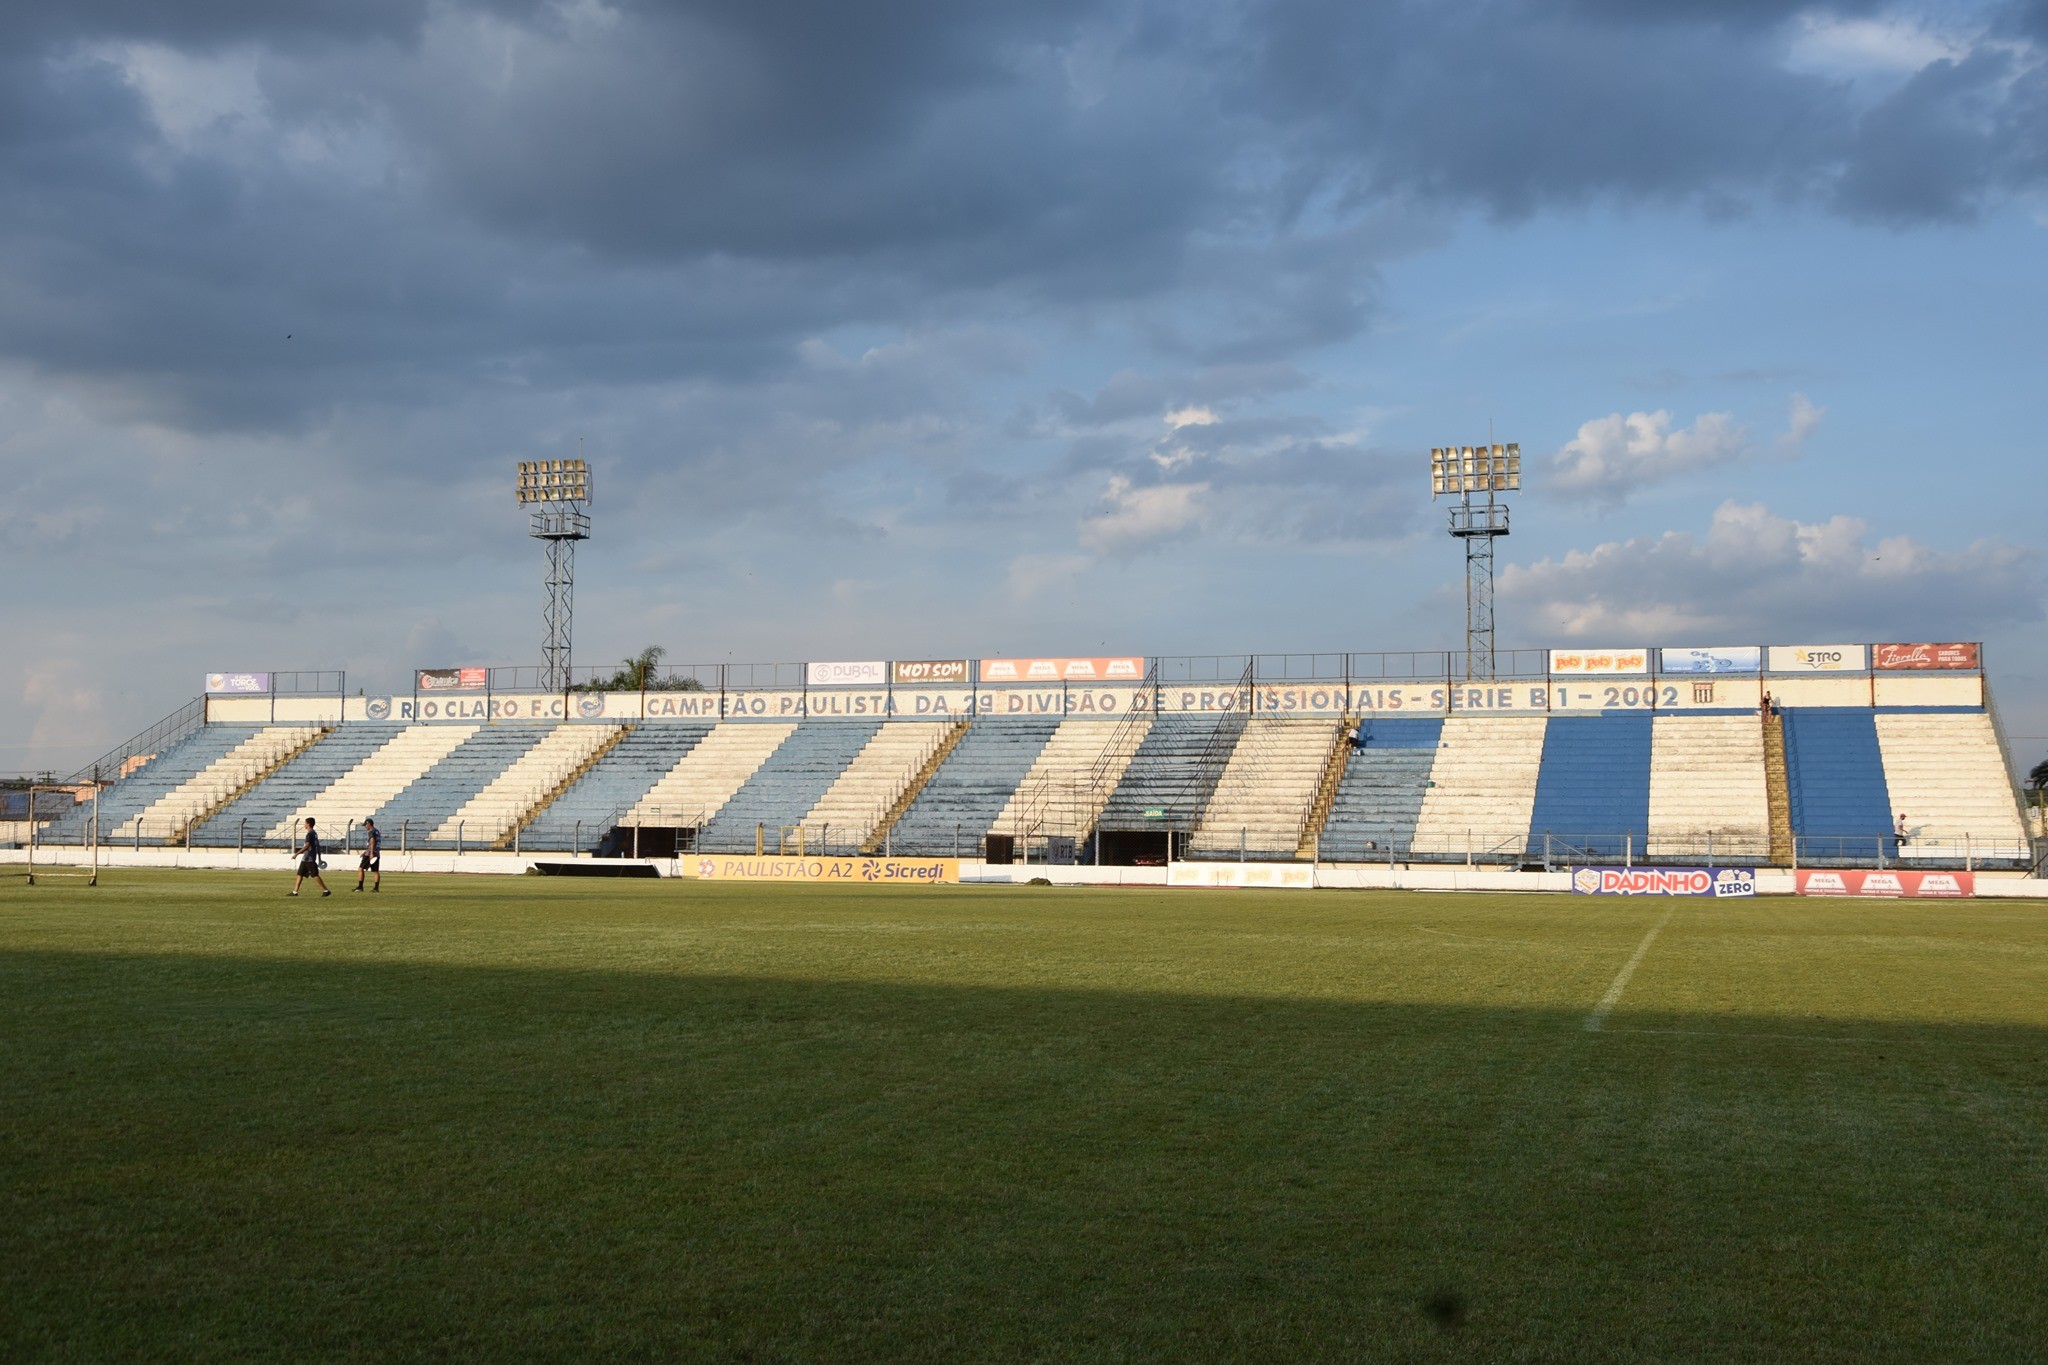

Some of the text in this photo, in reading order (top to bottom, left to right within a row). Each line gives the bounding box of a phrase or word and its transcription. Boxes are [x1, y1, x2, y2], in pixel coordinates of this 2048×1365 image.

[1880, 647, 1931, 666] Fiorella
[833, 665, 879, 678] DUBAL
[899, 662, 963, 677] HOT SOM
[230, 678, 257, 687] TORCE
[401, 701, 437, 718] RIO
[445, 700, 518, 718] CLARO
[647, 693, 766, 716] CAMPEÃO
[780, 695, 898, 714] PAULISTA
[916, 694, 949, 713] DA
[1008, 690, 1117, 713] DIVISÃO
[1132, 692, 1166, 711] DE
[1182, 690, 1403, 711] PROFISSIONAIS
[1431, 684, 1513, 709] SÉRIE
[1603, 686, 1679, 707] 2002
[723, 859, 944, 878] PAULISTÃO A2 Sicredi
[1602, 870, 1711, 893] DADINHO
[1719, 882, 1752, 895] ZERO
